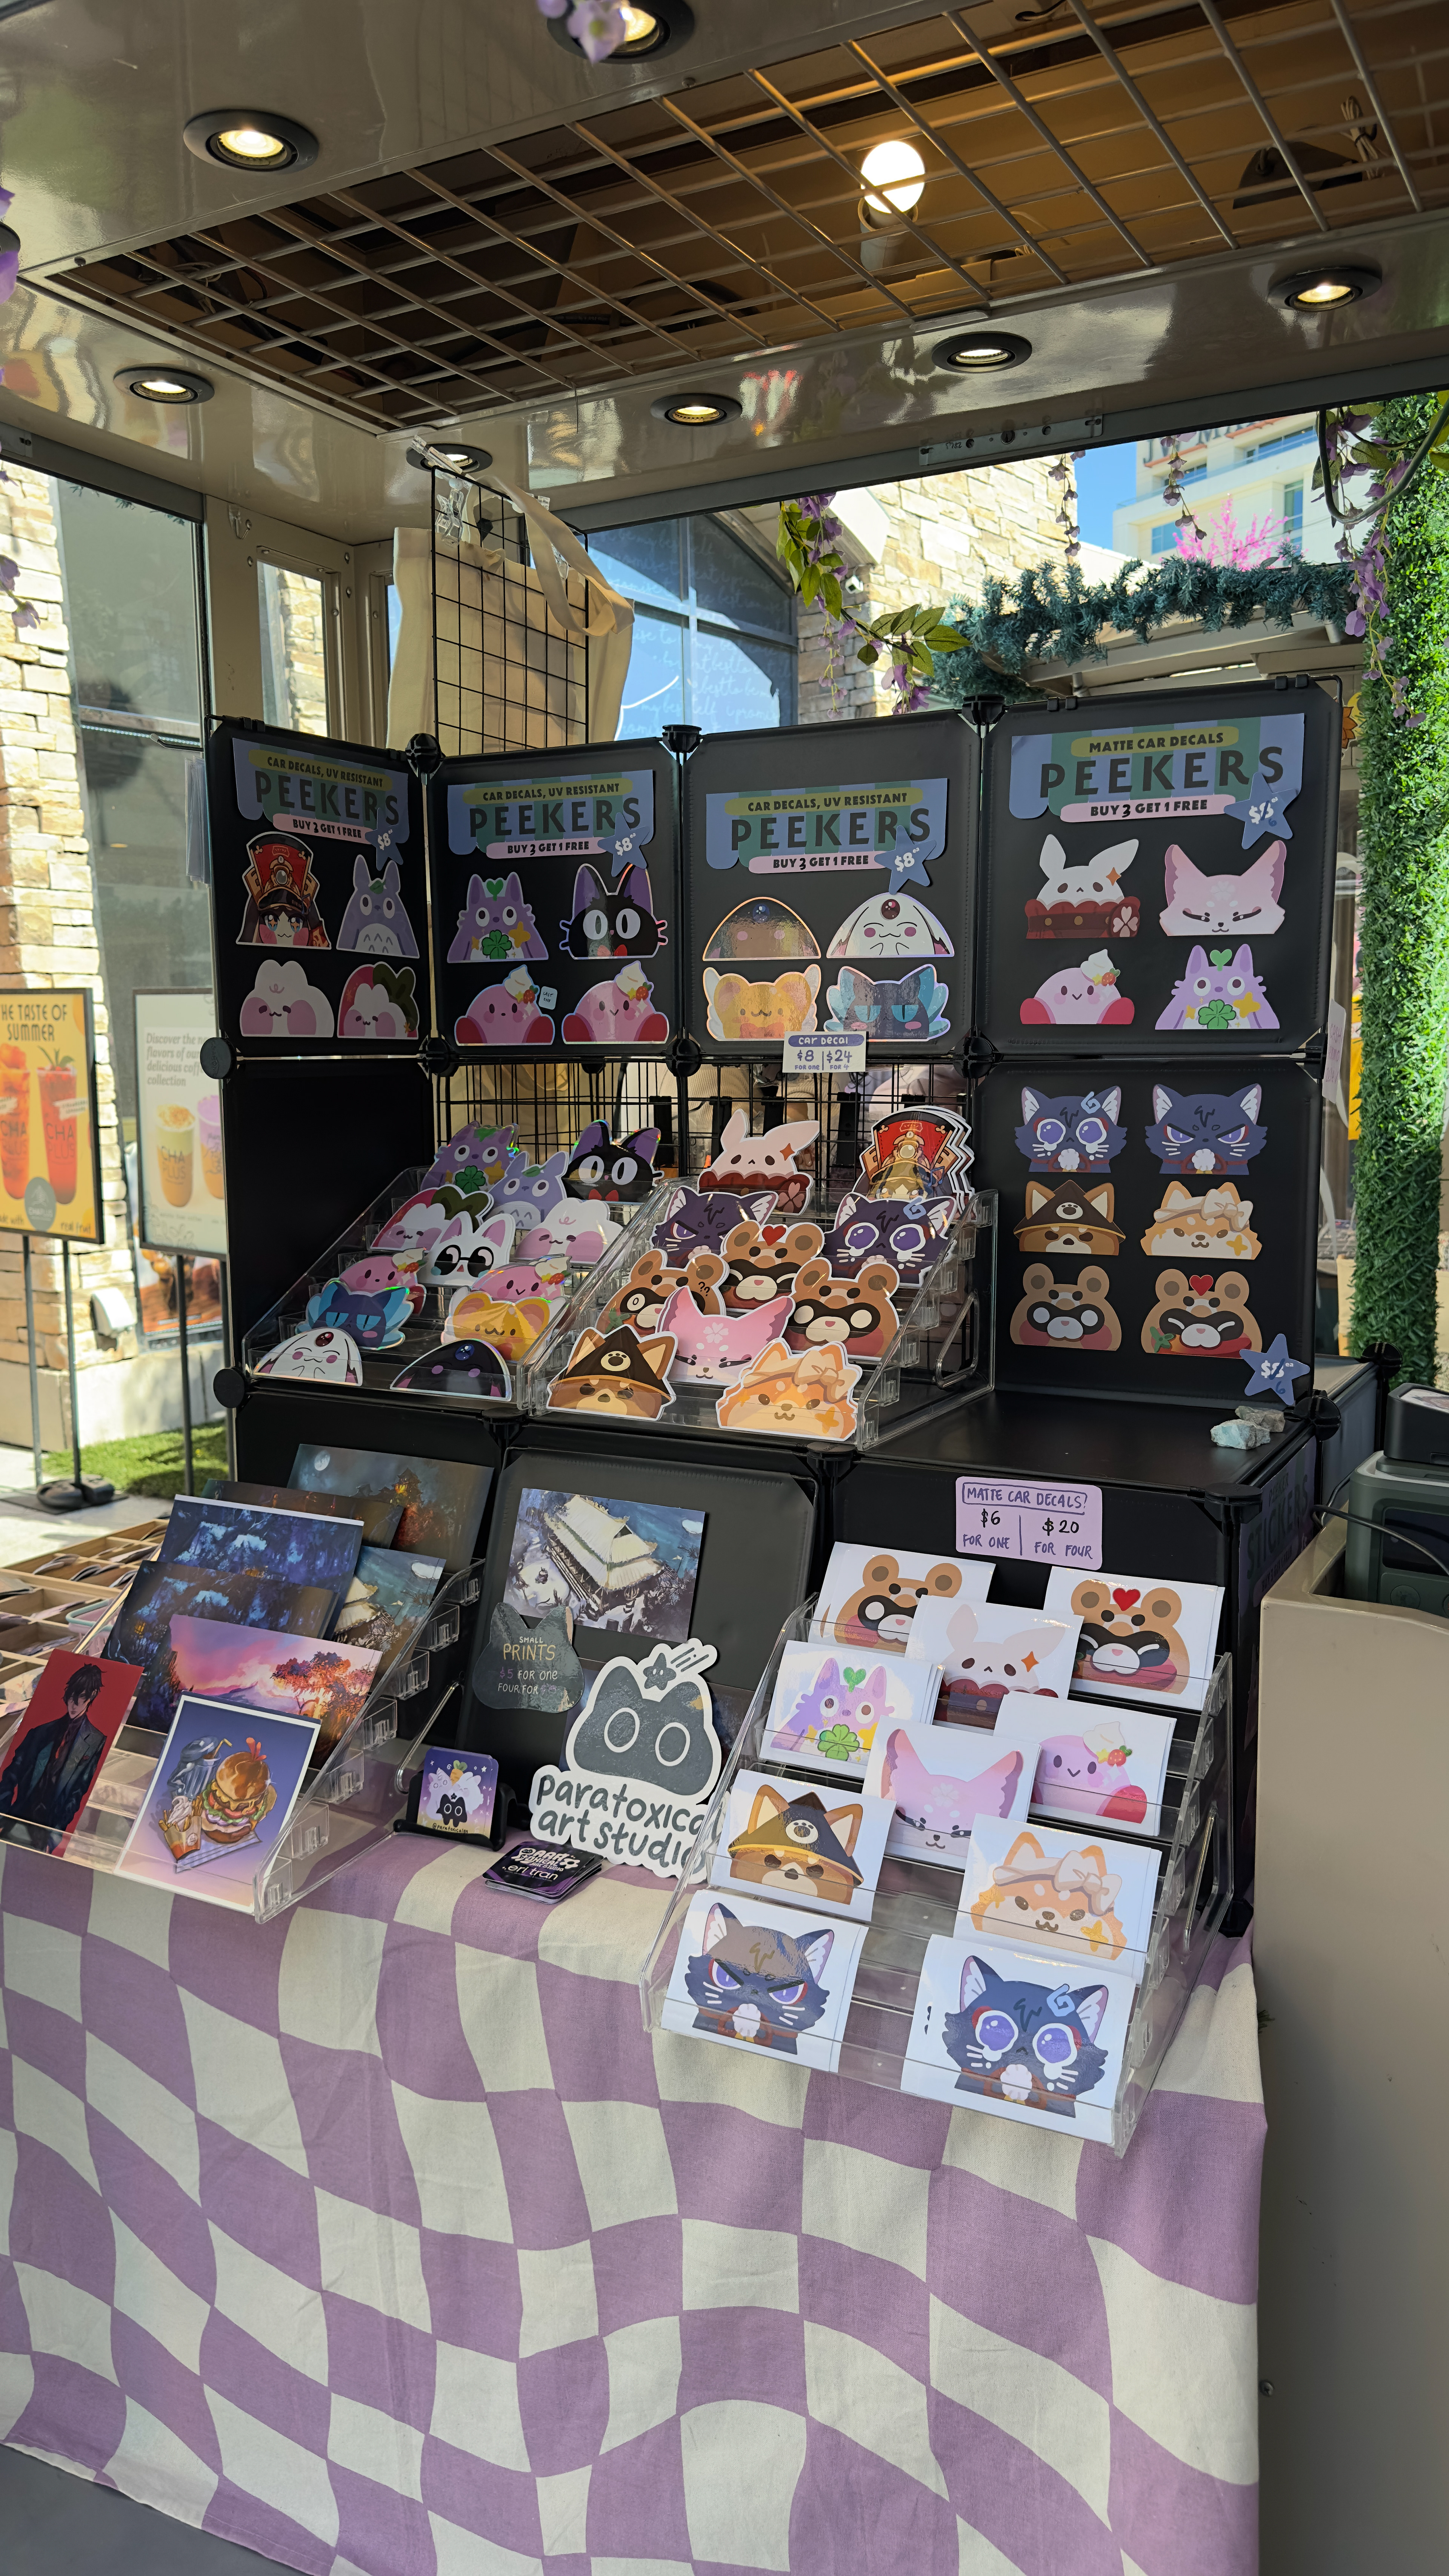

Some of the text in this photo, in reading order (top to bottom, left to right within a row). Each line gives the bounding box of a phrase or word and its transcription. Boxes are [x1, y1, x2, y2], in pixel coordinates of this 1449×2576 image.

[1089, 732, 1223, 753] MATTE CAR DECALS
[267, 757, 383, 787] CAR DECALS, UV RESISTANT
[1040, 746, 1283, 798] PEEKERS
[255, 770, 399, 825] PEEKERS
[483, 783, 620, 801] CAR DECALS, UV RESISTANT
[748, 793, 908, 812] CAR DECALS, UV RESISTANT
[1090, 799, 1208, 818] BUY 3 GET 1 FREE
[470, 797, 640, 838] PEEKERS
[1268, 818, 1277, 827] 6
[293, 819, 311, 830] BUY
[320, 823, 335, 834] GET
[343, 827, 361, 838] FREE
[731, 808, 930, 851] PEEKERS
[377, 832, 391, 850] $8
[508, 844, 528, 854] BUY
[538, 843, 557, 852] GET
[559, 842, 563, 851] 1
[565, 841, 589, 851] FREE
[615, 837, 633, 856] $8
[773, 859, 796, 869] BUY
[809, 857, 831, 867] GET
[833, 857, 838, 866] 1
[840, 855, 869, 865] FREE
[894, 852, 915, 872] $8
[0, 1004, 67, 1021] HE TASTE OF
[7, 1023, 55, 1041] SUMMER
[147, 1032, 207, 1044] Discover the ne
[147, 1046, 200, 1061] flavors of our
[797, 1049, 814, 1062] $8
[826, 1049, 852, 1063] $24
[147, 1061, 205, 1076] delicious coff
[147, 1074, 186, 1087] collection
[1, 1120, 27, 1137] CHA
[46, 1123, 74, 1141] CHA
[161, 1146, 185, 1164] CHA
[1275, 1381, 1286, 1395] 6
[968, 1487, 1002, 1501] MATTE
[1008, 1490, 1030, 1504] CAR
[981, 1508, 1000, 1527] $6
[1042, 1517, 1079, 1536] $20
[963, 1534, 1010, 1549] FOR ONE
[1034, 1541, 1093, 1559] FOR FOUR
[503, 1643, 556, 1661] PRINTS
[500, 1666, 514, 1679] $5
[518, 1670, 535, 1680] FOR
[498, 1683, 520, 1693] FOUR
[522, 1685, 538, 1694] FOR
[539, 1810, 590, 1842] art
[594, 1822, 705, 1875] studio
[508, 1864, 529, 1874] eri
[531, 1866, 558, 1880] tran
